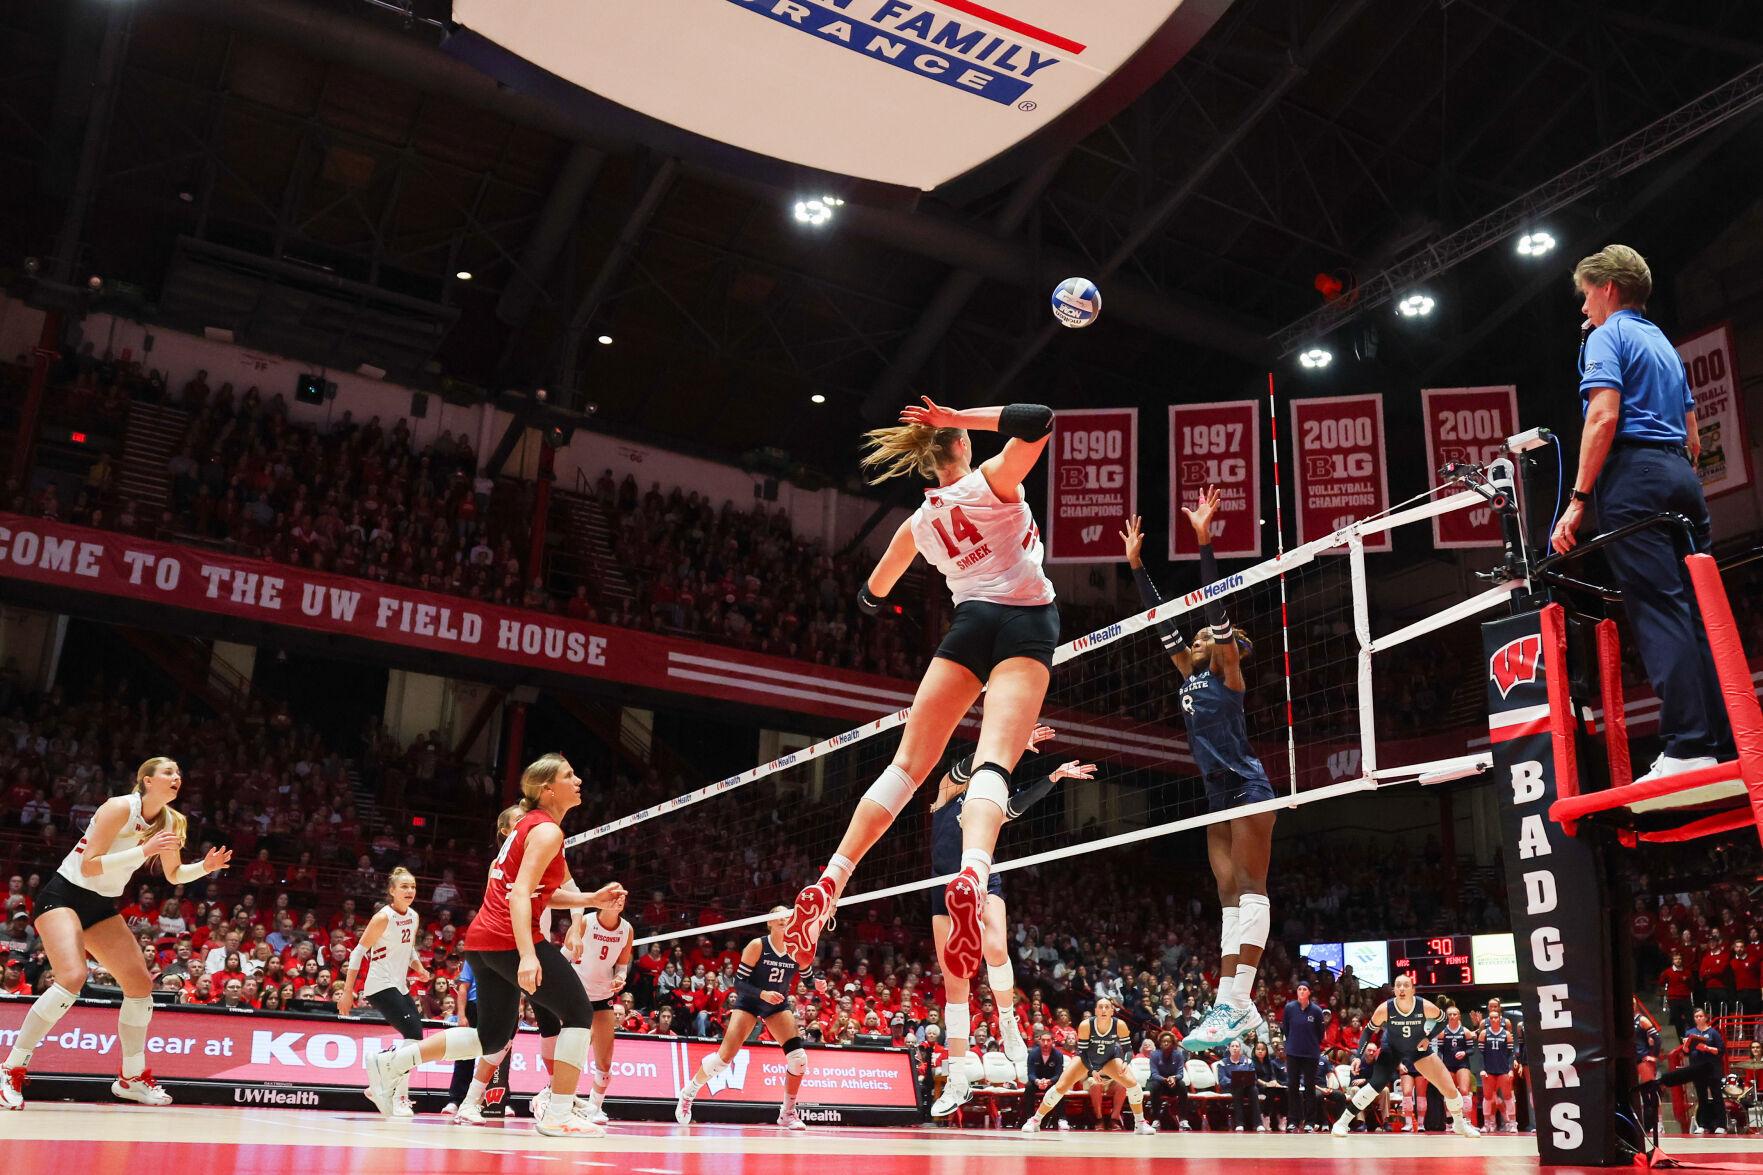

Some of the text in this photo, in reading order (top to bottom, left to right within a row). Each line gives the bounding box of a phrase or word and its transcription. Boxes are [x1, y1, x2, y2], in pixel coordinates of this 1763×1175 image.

[770, 0, 995, 90] RANCE
[870, 0, 1061, 78] FAMILY
[1438, 409, 1503, 440] 2001
[1182, 423, 1244, 455] 1997
[1303, 416, 1373, 449] 2000
[1062, 430, 1122, 460] 1990
[1182, 487, 1246, 500] VOLBALL
[1308, 481, 1374, 495] VOLLEYBALL
[1060, 493, 1123, 505] VOLLEYBALL
[1308, 494, 1375, 509] CHAMPIONS
[1060, 505, 1124, 518] CHAMPIONS
[931, 506, 984, 559] 14
[956, 544, 992, 571] SMREK
[124, 550, 181, 591] TO
[201, 564, 285, 610] THE
[301, 583, 361, 622] UW
[376, 597, 482, 644] FIELD
[497, 619, 607, 666] HOUSE
[401, 929, 411, 943] 22
[593, 933, 620, 942] WISCONSIN
[599, 946, 609, 960] 9
[1510, 760, 1584, 1150] BADGERS
[763, 959, 777, 967] PENN
[768, 967, 785, 983] 21
[1431, 972, 1436, 984] 1
[1461, 966, 1471, 984] 3
[1402, 1026, 1411, 1038] 9
[148, 1036, 196, 1055] ear
[204, 1037, 233, 1057] at
[1096, 1045, 1105, 1054] 2
[1491, 1041, 1499, 1050] 11
[823, 1067, 856, 1077] proud
[859, 1069, 898, 1079] partner
[764, 1076, 776, 1086] of
[841, 1080, 892, 1090] Athletics.
